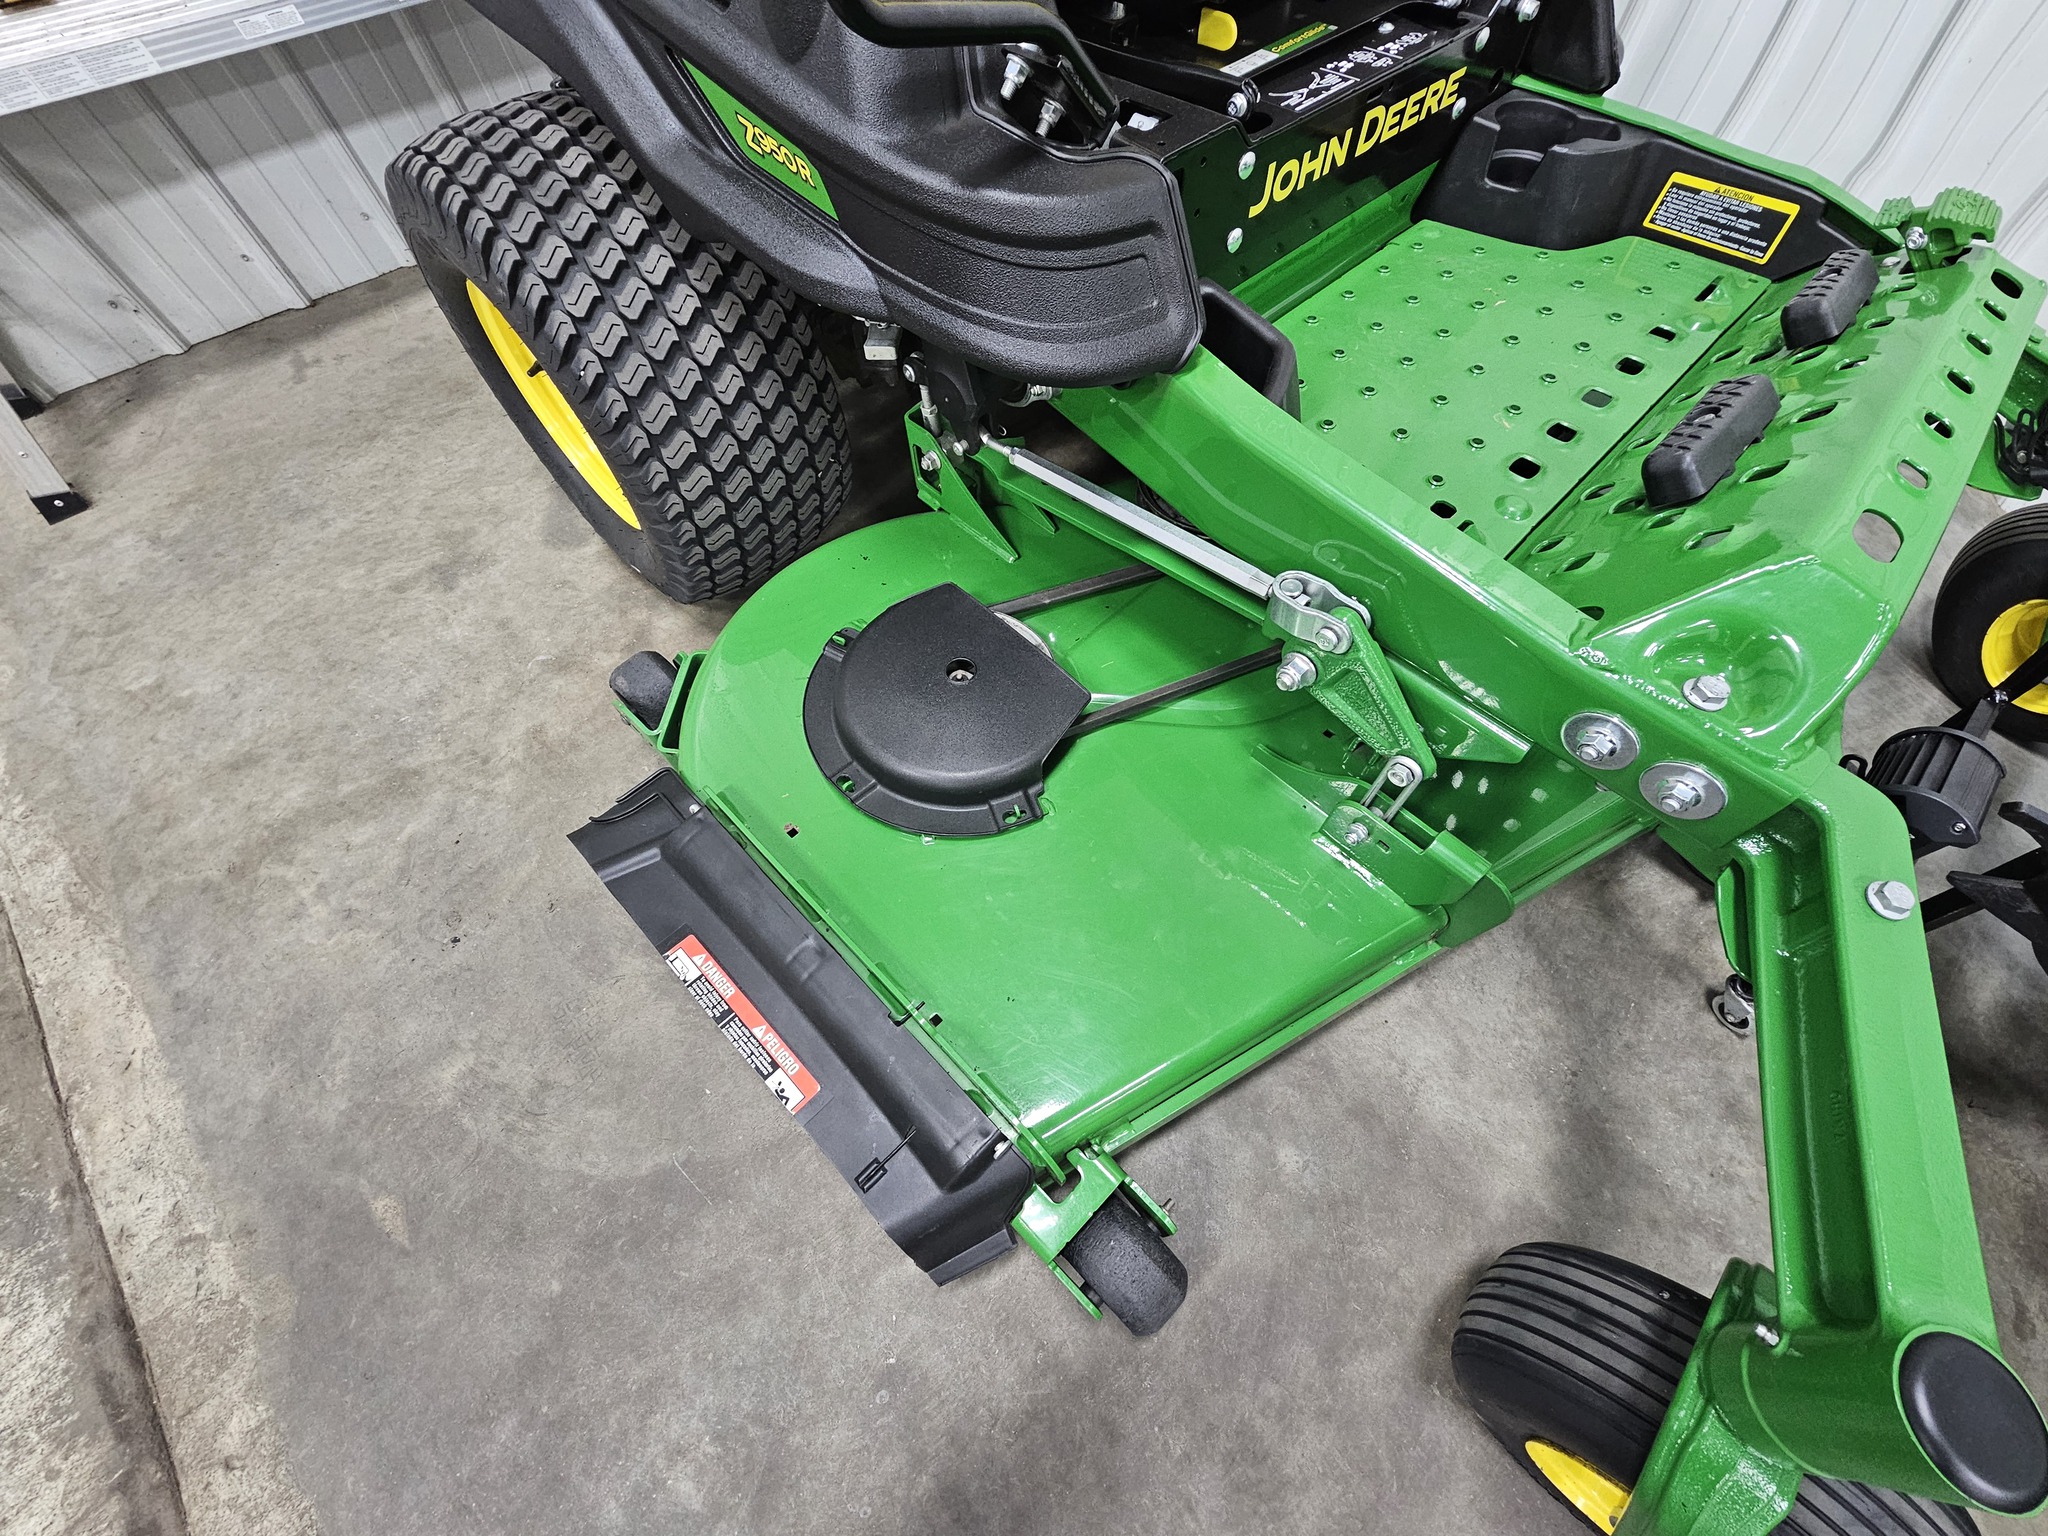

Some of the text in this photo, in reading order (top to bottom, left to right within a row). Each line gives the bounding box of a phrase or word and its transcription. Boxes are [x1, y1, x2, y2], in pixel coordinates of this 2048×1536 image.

[735, 111, 817, 190] Z950R
[1248, 66, 1467, 218] JOHN DEERE
[1721, 187, 1755, 202] ATENCION
[701, 961, 735, 999] DANGER
[762, 1032, 800, 1075] PELIGRO
